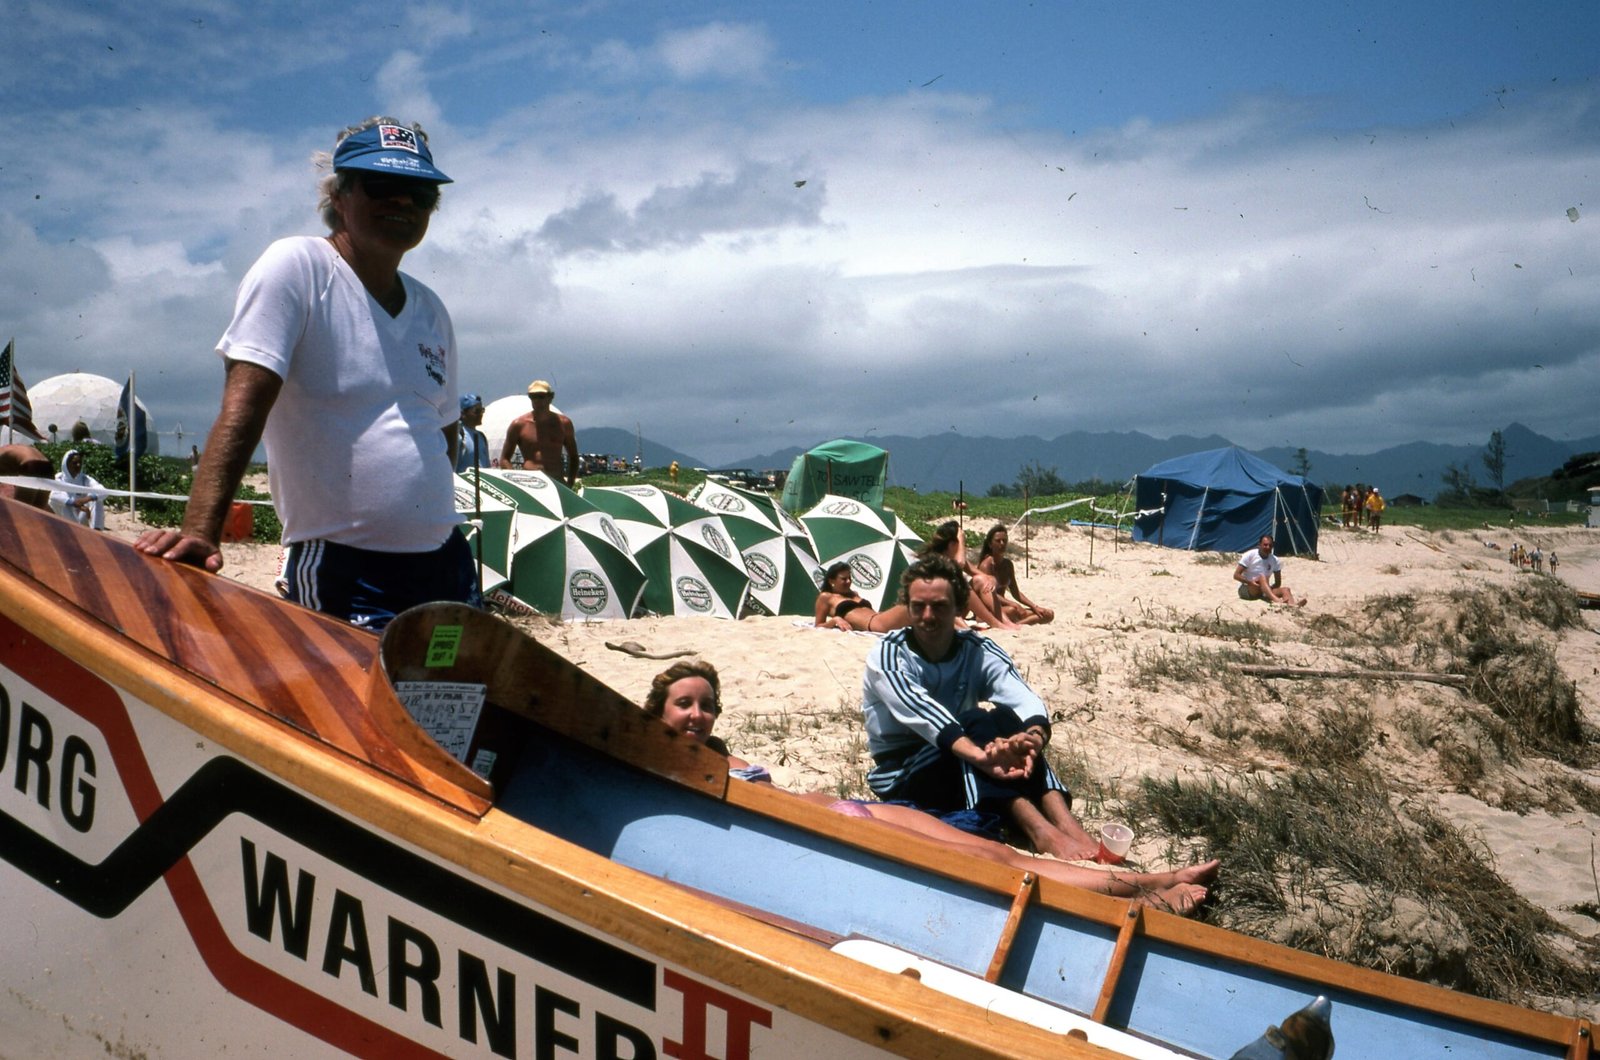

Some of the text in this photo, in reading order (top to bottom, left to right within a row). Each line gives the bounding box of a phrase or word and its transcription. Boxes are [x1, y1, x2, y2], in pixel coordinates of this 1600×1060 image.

[745, 559, 774, 584] Heineken
[850, 559, 878, 585] Heineken
[572, 587, 605, 596] Heineken
